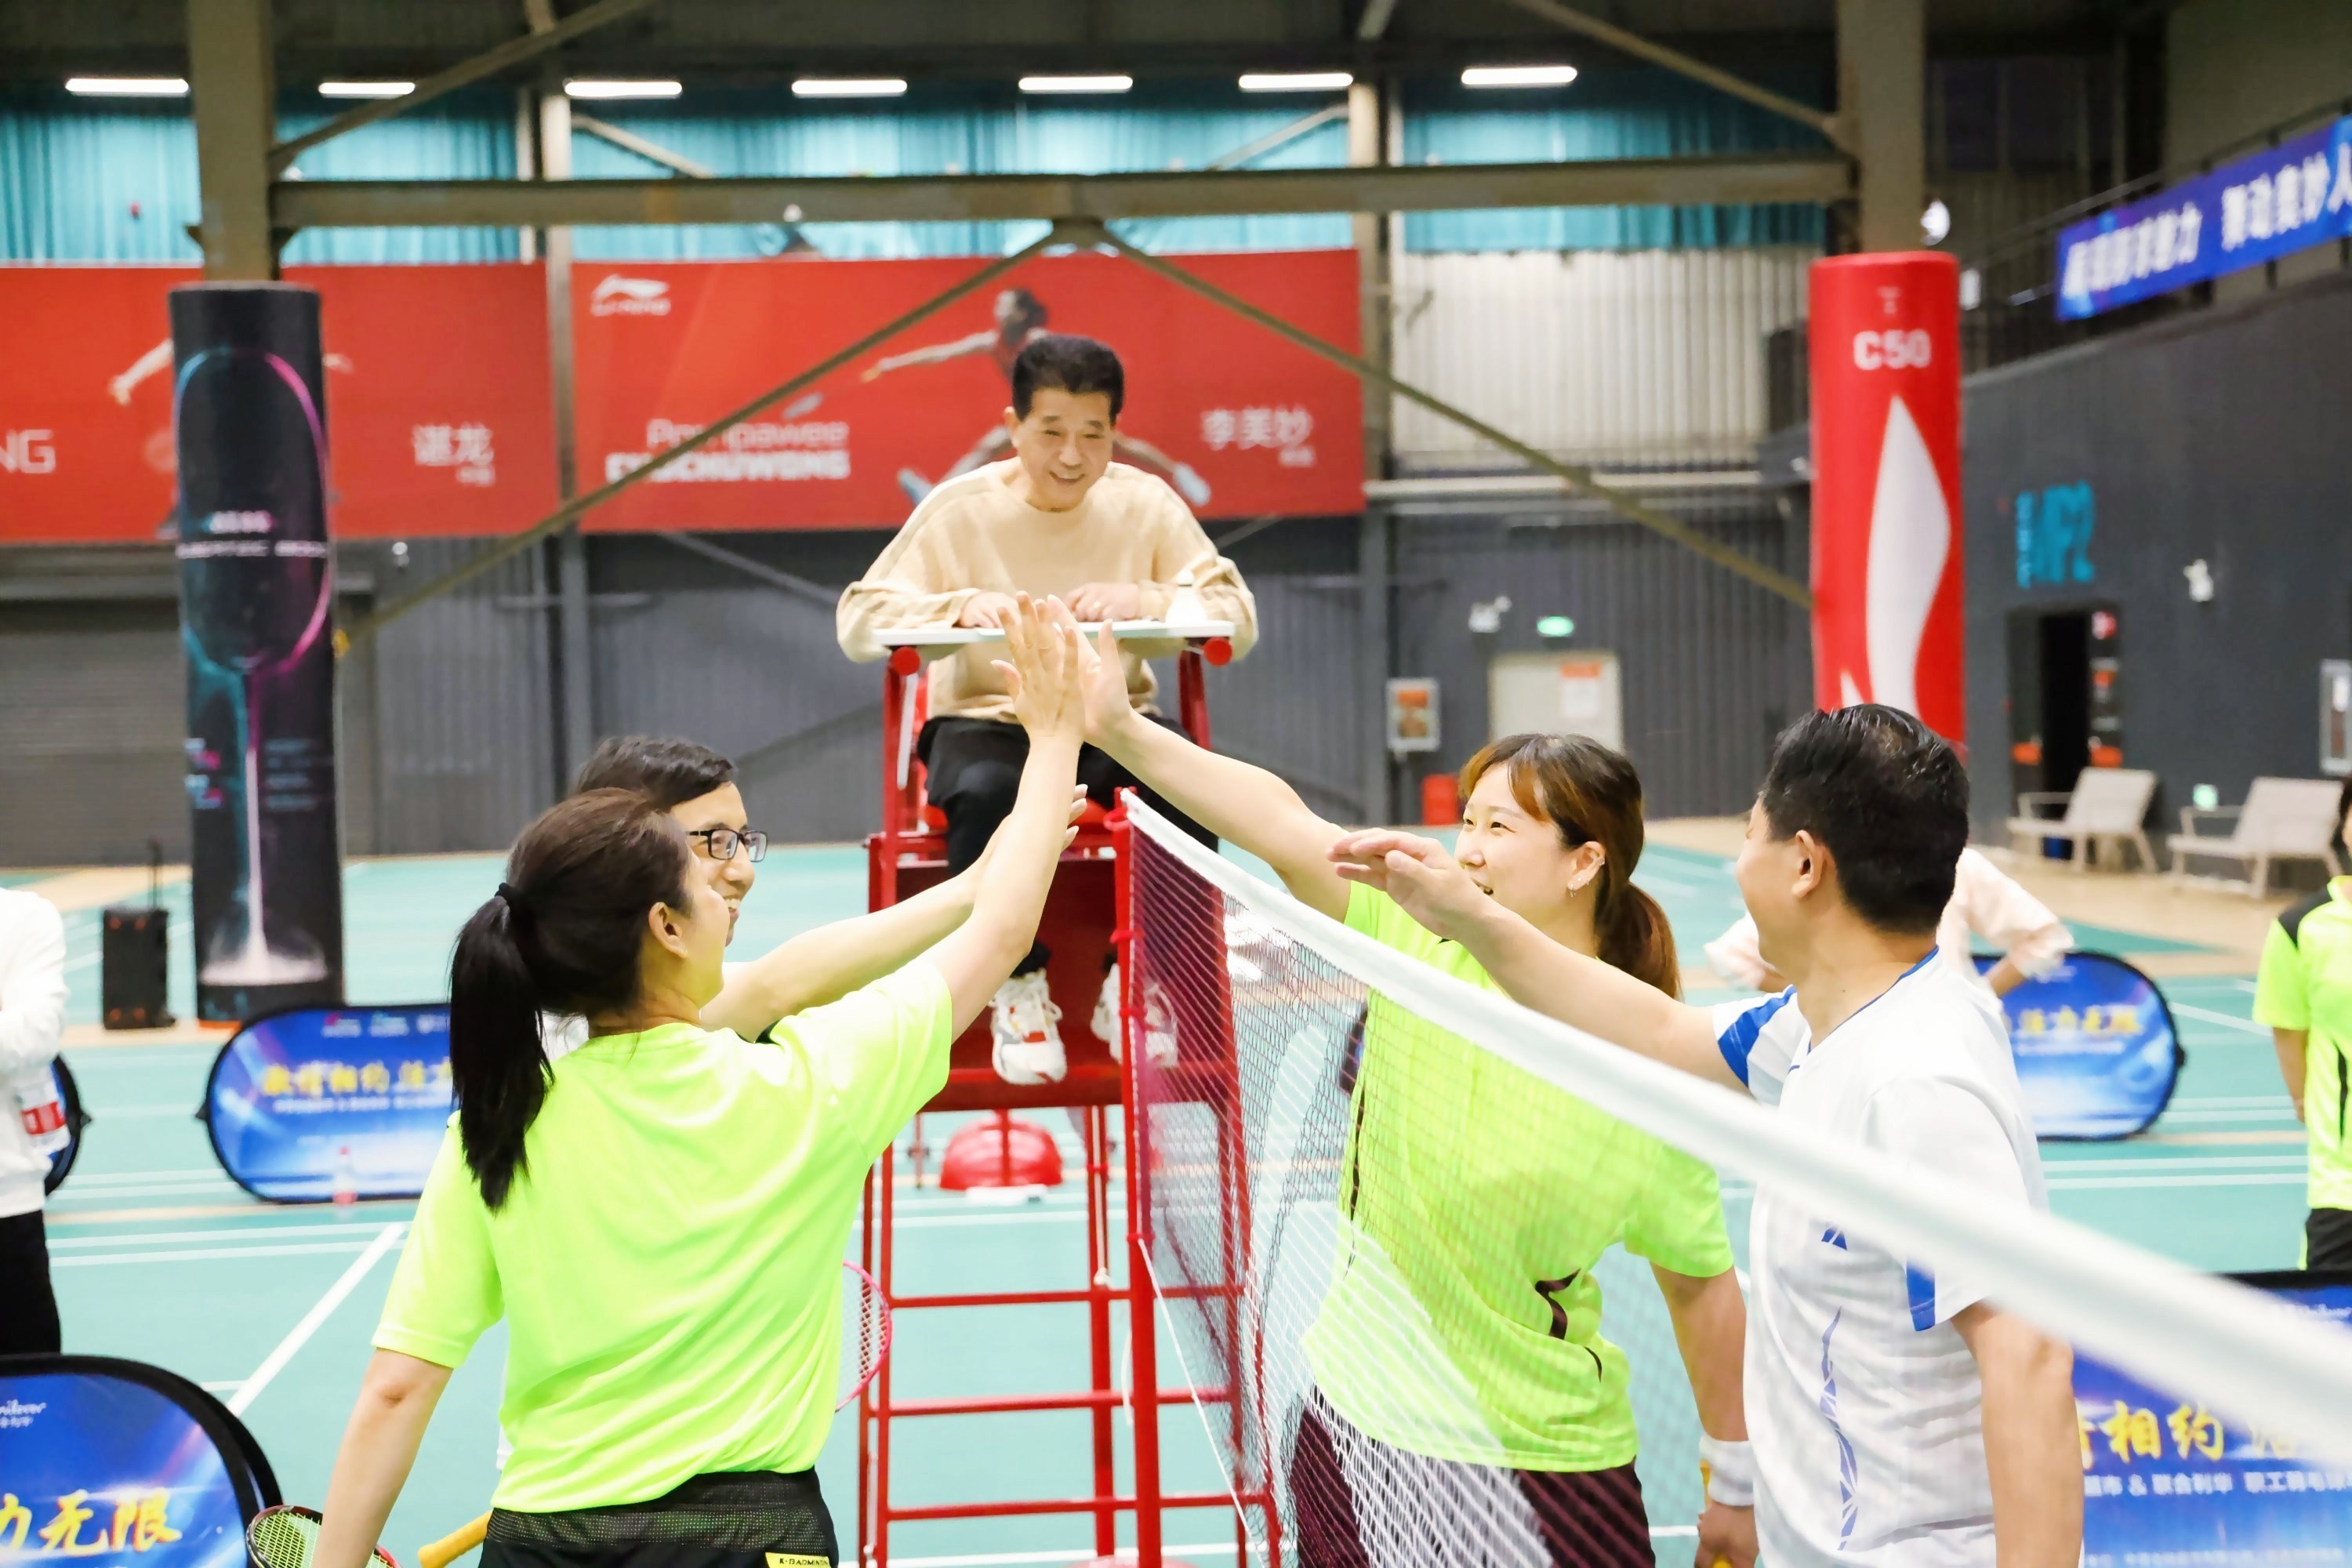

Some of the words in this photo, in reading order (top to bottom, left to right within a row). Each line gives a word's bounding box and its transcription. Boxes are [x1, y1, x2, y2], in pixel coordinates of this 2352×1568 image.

[1853, 328, 1931, 370] C50
[2078, 1400, 2224, 1469] 相约
[2128, 1474, 2147, 1497] &
